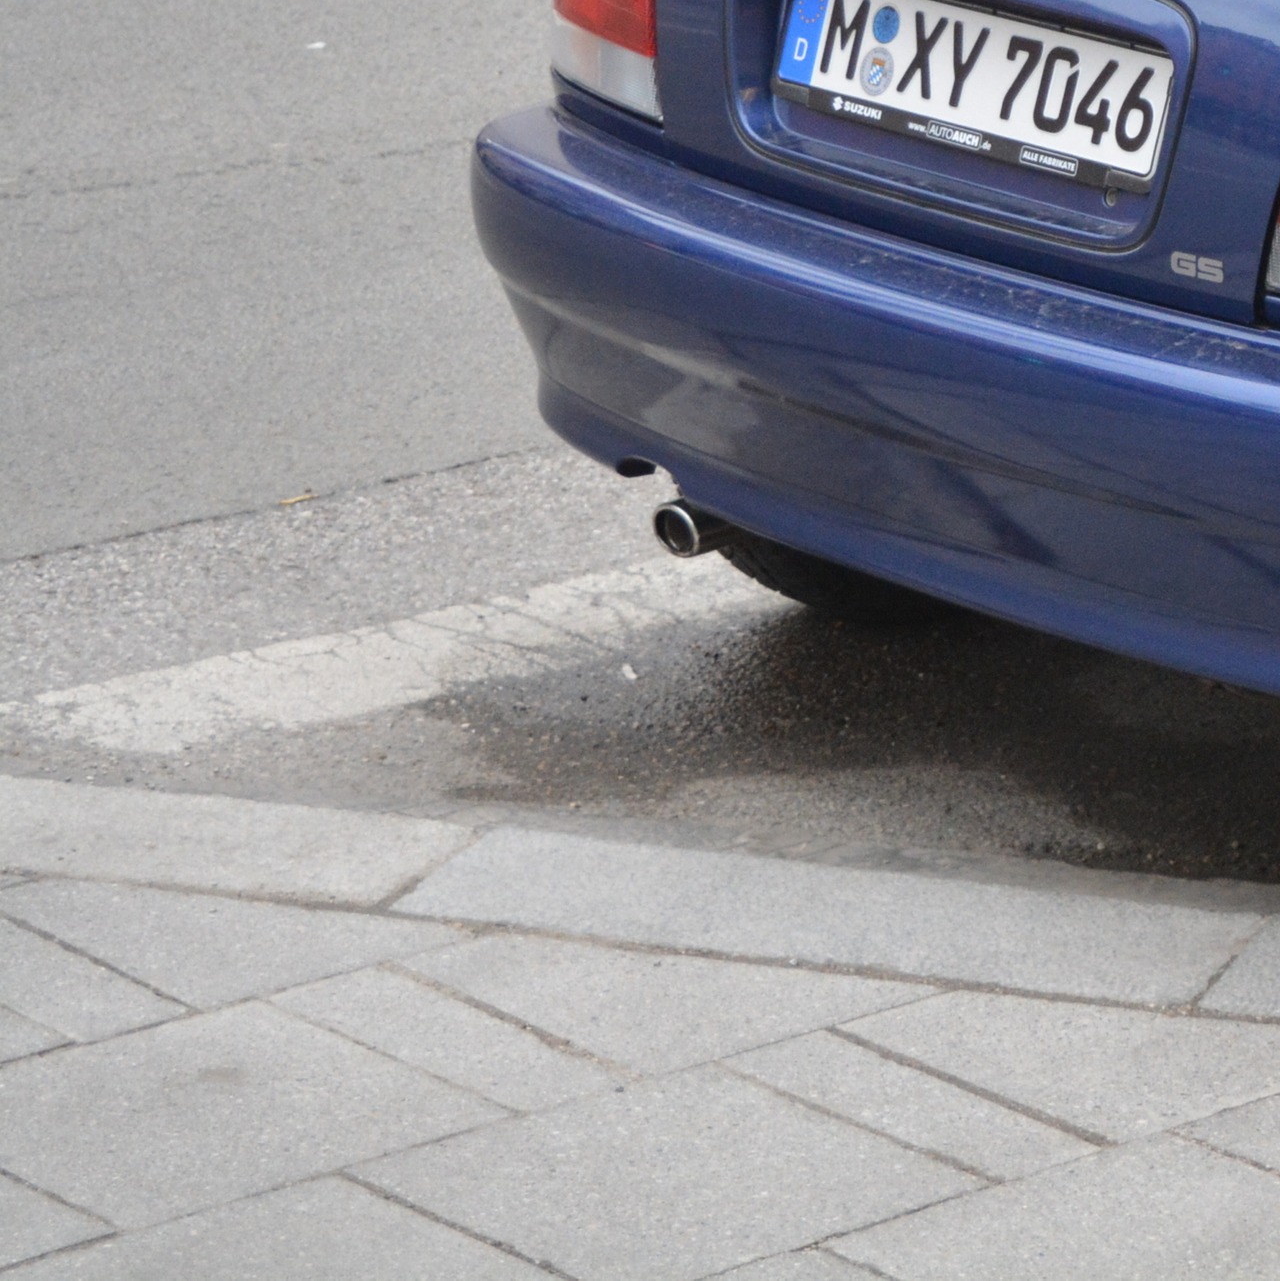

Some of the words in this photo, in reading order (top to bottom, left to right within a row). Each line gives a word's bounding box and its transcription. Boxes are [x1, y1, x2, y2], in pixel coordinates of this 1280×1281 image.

[793, 37, 808, 61] D
[896, 10, 990, 108] XY
[999, 34, 1155, 153] 7046
[843, 101, 882, 120] SUZUKI
[1022, 150, 1039, 163] ALLE
[1039, 154, 1076, 172] FABRIKATE
[1170, 250, 1224, 283] GS
